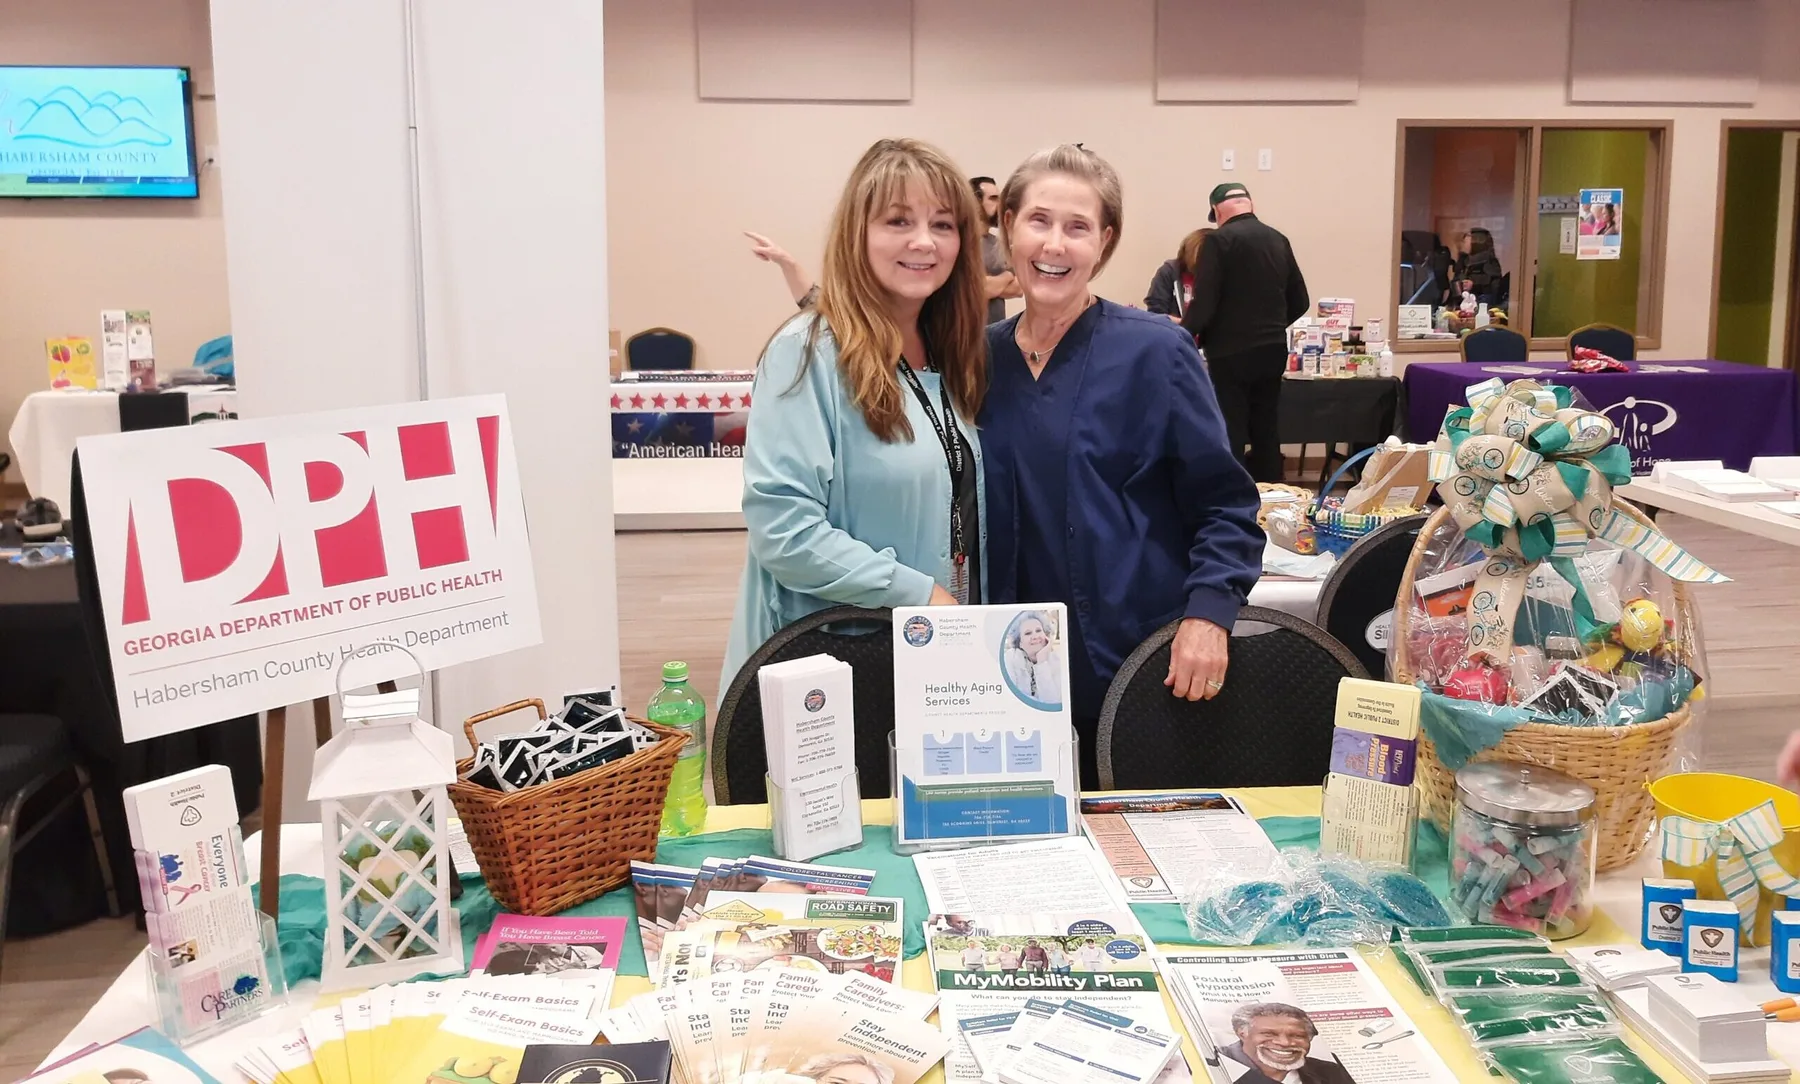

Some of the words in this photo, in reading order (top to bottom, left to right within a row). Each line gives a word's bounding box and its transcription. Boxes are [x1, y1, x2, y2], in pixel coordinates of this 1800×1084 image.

[96, 152, 158, 163] COUNTY
[926, 405, 938, 426] District
[950, 426, 960, 444] Public
[1630, 456, 1640, 468] of
[121, 414, 502, 627] DPH
[123, 625, 216, 657] GEORGIA
[220, 600, 344, 638] DEPARTMENT
[348, 594, 372, 611] OF
[375, 582, 438, 608] PUBLIC
[441, 568, 503, 594] HEALTH
[132, 666, 260, 709] Habersham
[264, 641, 335, 681] County
[340, 636, 401, 662] Health
[404, 610, 509, 650] Department
[925, 682, 968, 694] Healthy
[970, 682, 1002, 695] Aging
[925, 696, 970, 707] Services
[1348, 711, 1364, 720] HEALTH
[1364, 714, 1378, 722] PUBLIC
[1382, 717, 1400, 726] DISTRICT
[810, 721, 836, 730] Department
[980, 728, 986, 736] 2
[1020, 726, 1026, 735] 3
[942, 730, 945, 738] 1
[1366, 738, 1380, 776] Pressure
[1377, 744, 1390, 775] Blood
[176, 784, 202, 796] District
[169, 798, 188, 807] Health
[188, 793, 205, 801] Public
[196, 840, 206, 866] Breast
[211, 834, 228, 888] Everyone
[780, 866, 830, 877] COLORECTAL
[831, 872, 862, 880] CANCER
[200, 868, 211, 892] Cancer
[815, 878, 859, 886] SCREENING
[812, 903, 844, 911] ROAD
[847, 904, 891, 913] SAFETY
[674, 944, 692, 966] Not
[1256, 954, 1296, 962] Pressure
[1298, 952, 1318, 960] with
[1320, 952, 1338, 960] Diet
[778, 972, 819, 984] Family
[953, 973, 1090, 989] MyMobility
[1094, 974, 1144, 988] Plan
[1192, 975, 1244, 984] Postural
[776, 980, 824, 993] Caregiv
[850, 978, 888, 996] Family
[1196, 980, 1276, 991] Hypotension
[772, 989, 797, 997] Protect
[844, 986, 906, 1012] Caregivers:
[1054, 994, 1072, 1002] stay
[201, 988, 233, 1012] CARE
[214, 989, 264, 1020] PARTNERS
[535, 996, 580, 1006] Basics
[836, 992, 860, 1004] Protect
[862, 1001, 876, 1010] Your
[468, 1006, 537, 1028] Self-Exam
[540, 1022, 585, 1037] Basics
[858, 1018, 886, 1032] Stay
[837, 1037, 878, 1056] prevention.
[844, 1032, 864, 1044] Learn
[865, 1040, 884, 1051] more
[884, 1048, 906, 1060] about
[906, 1055, 920, 1064] fall
[850, 1025, 928, 1058] Independent
